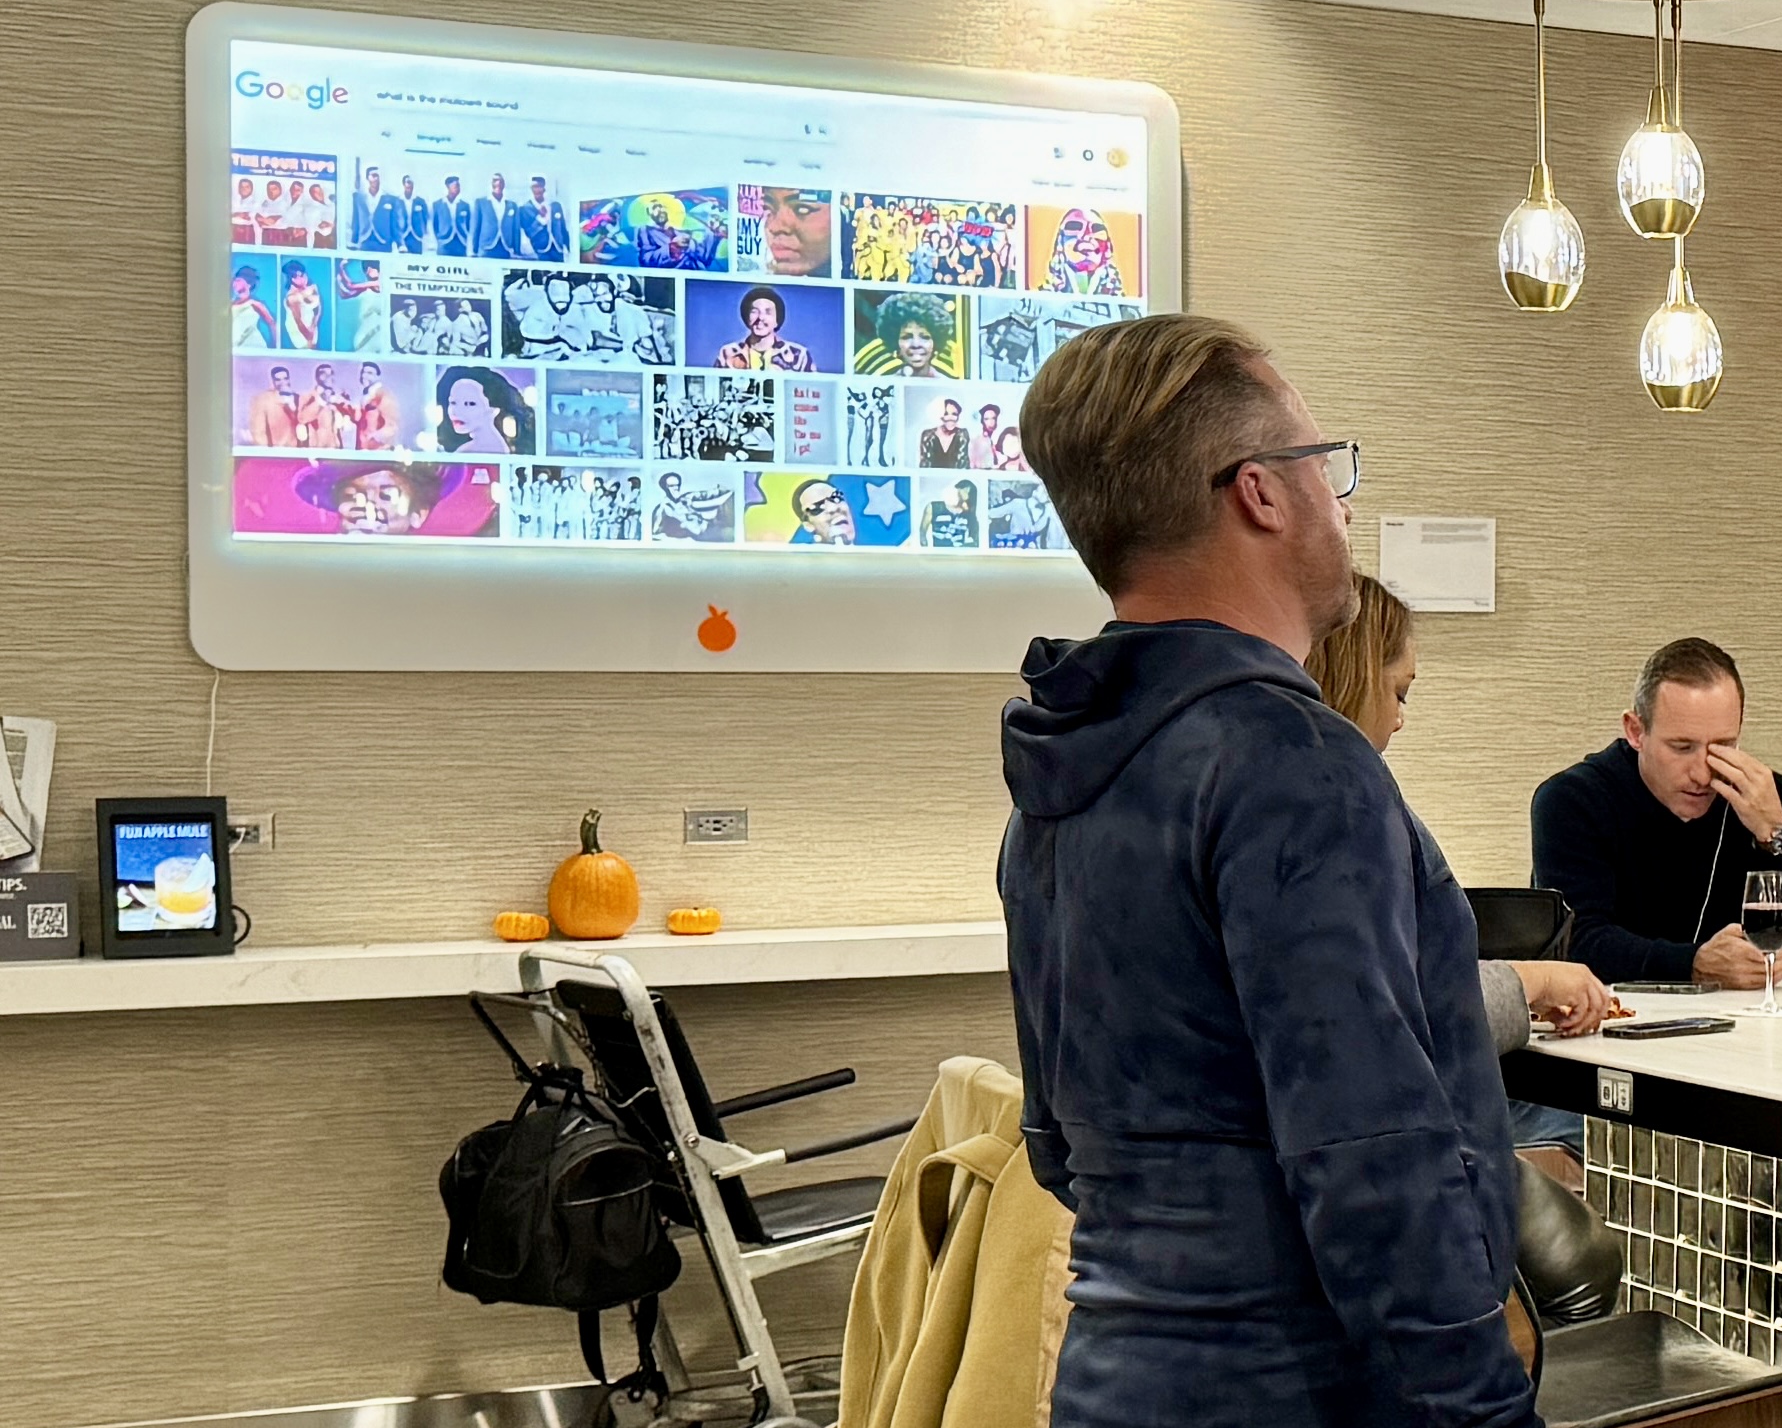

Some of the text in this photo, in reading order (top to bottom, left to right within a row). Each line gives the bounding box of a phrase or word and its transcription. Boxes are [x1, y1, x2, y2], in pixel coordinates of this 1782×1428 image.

[235, 70, 349, 109] Google
[742, 217, 762, 237] MY
[737, 235, 762, 256] GUY
[144, 825, 177, 839] APPLE
[177, 824, 208, 838] MULE
